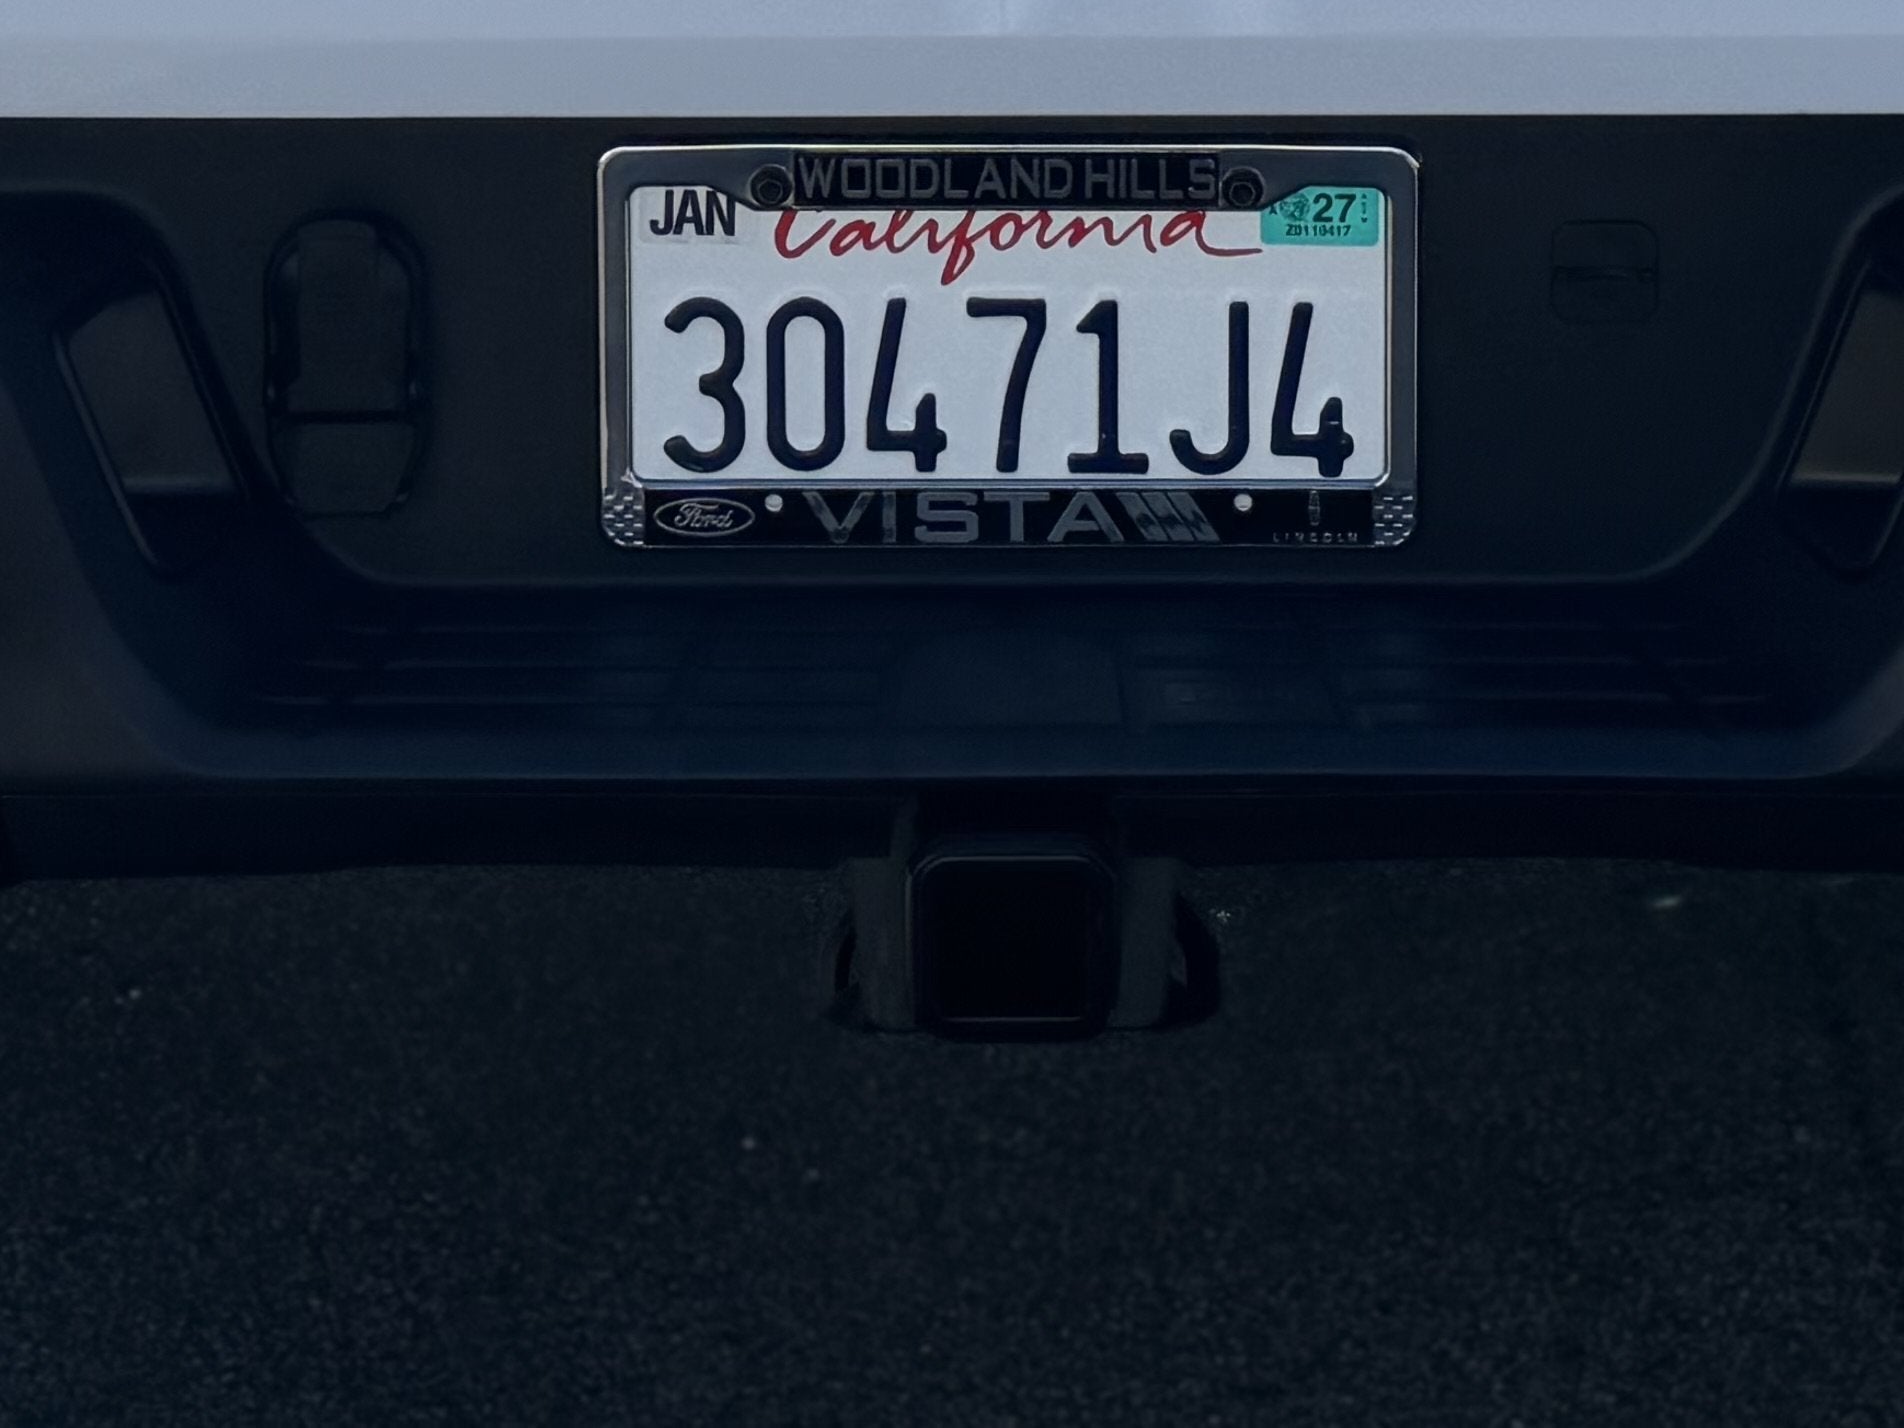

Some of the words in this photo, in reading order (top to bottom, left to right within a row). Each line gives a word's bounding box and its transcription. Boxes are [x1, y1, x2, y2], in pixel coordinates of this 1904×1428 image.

[798, 157, 1073, 199] WOODLAND
[1084, 157, 1216, 199] HILLS
[649, 188, 737, 236] JAN
[1312, 192, 1357, 223] 27
[662, 296, 1356, 477] 30471J4
[671, 504, 735, 529] Ford
[801, 490, 1125, 543] VISTA
